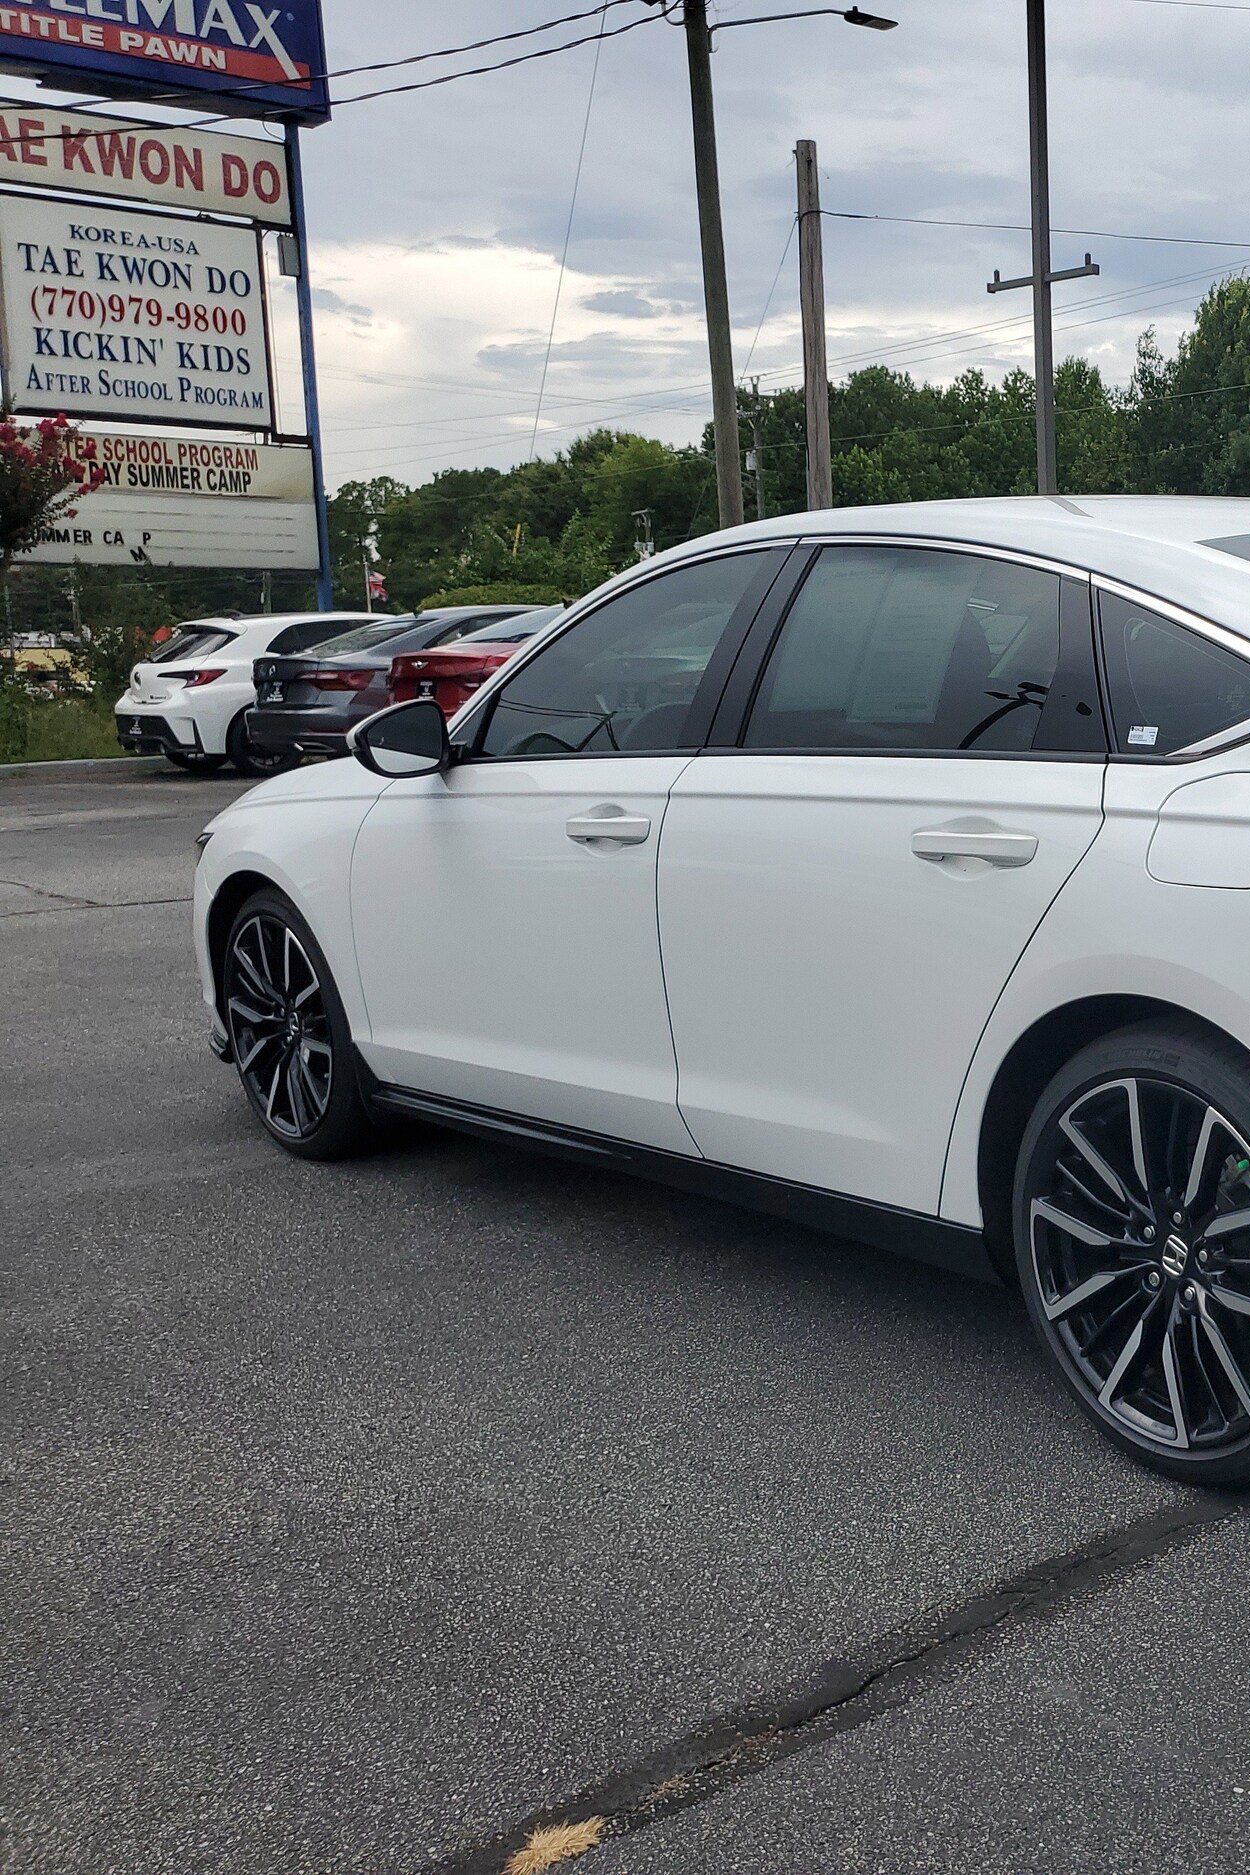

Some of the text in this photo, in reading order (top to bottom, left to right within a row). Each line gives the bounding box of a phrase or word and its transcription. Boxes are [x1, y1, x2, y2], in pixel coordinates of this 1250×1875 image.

[0, 9, 227, 70] TITLE PAWN
[61, 125, 205, 192] KWON
[221, 153, 281, 205] DO
[69, 224, 200, 256] KOREA-USA
[17, 242, 251, 297] TAE KWON DO
[31, 285, 247, 337] (770)979-9800
[33, 327, 251, 375] KICKIN' KIDS
[103, 438, 173, 465] SCHOOL
[178, 443, 259, 471] PROGRAM
[128, 463, 202, 490] SUMMER
[206, 468, 251, 493] CAMP
